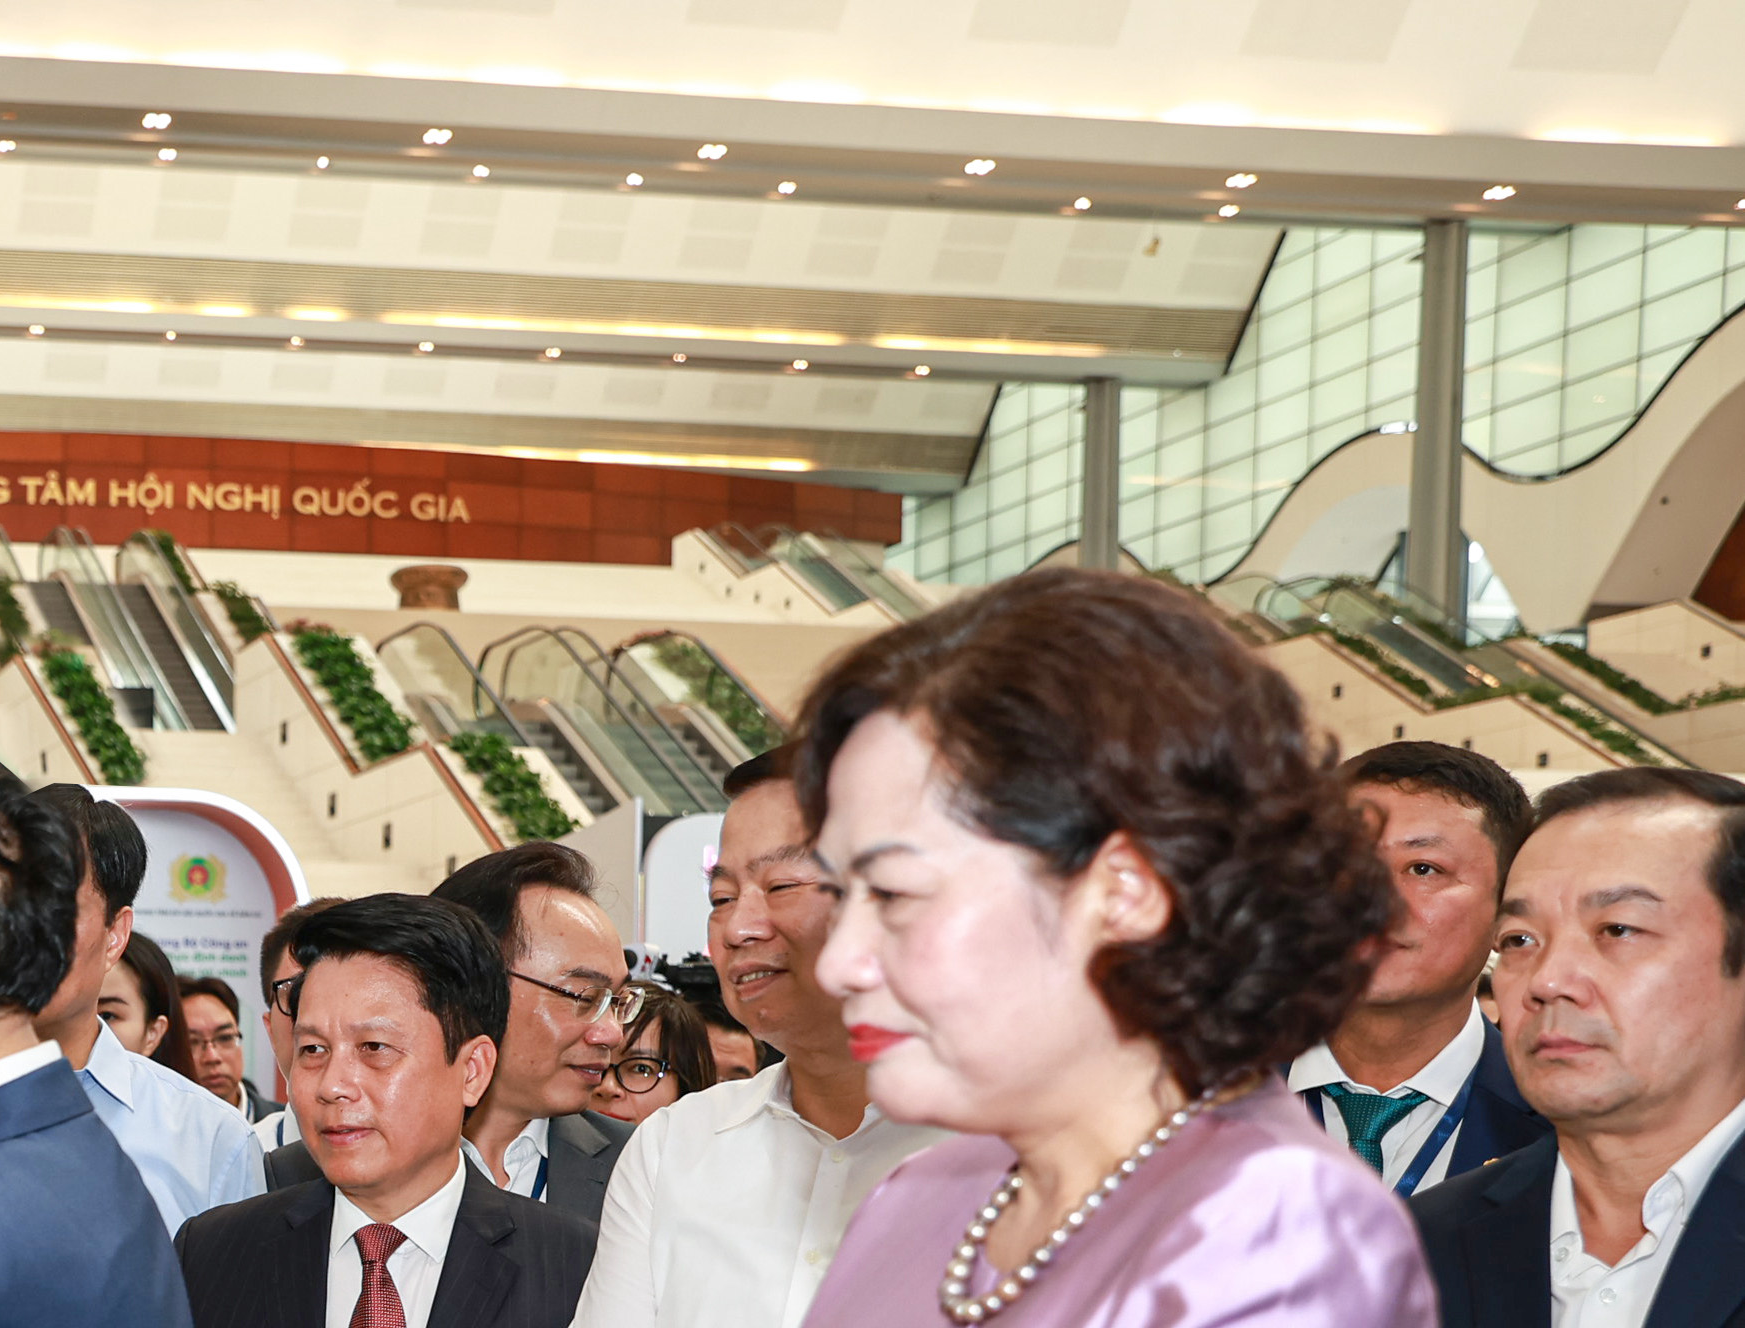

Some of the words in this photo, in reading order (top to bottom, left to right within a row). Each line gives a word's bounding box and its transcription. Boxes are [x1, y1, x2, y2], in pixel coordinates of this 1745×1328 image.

[19, 470, 96, 506] TÂM
[108, 472, 174, 515] HỘI
[186, 482, 280, 520] NGHỊ
[292, 478, 399, 518] QUỐC
[410, 492, 470, 523] GIA
